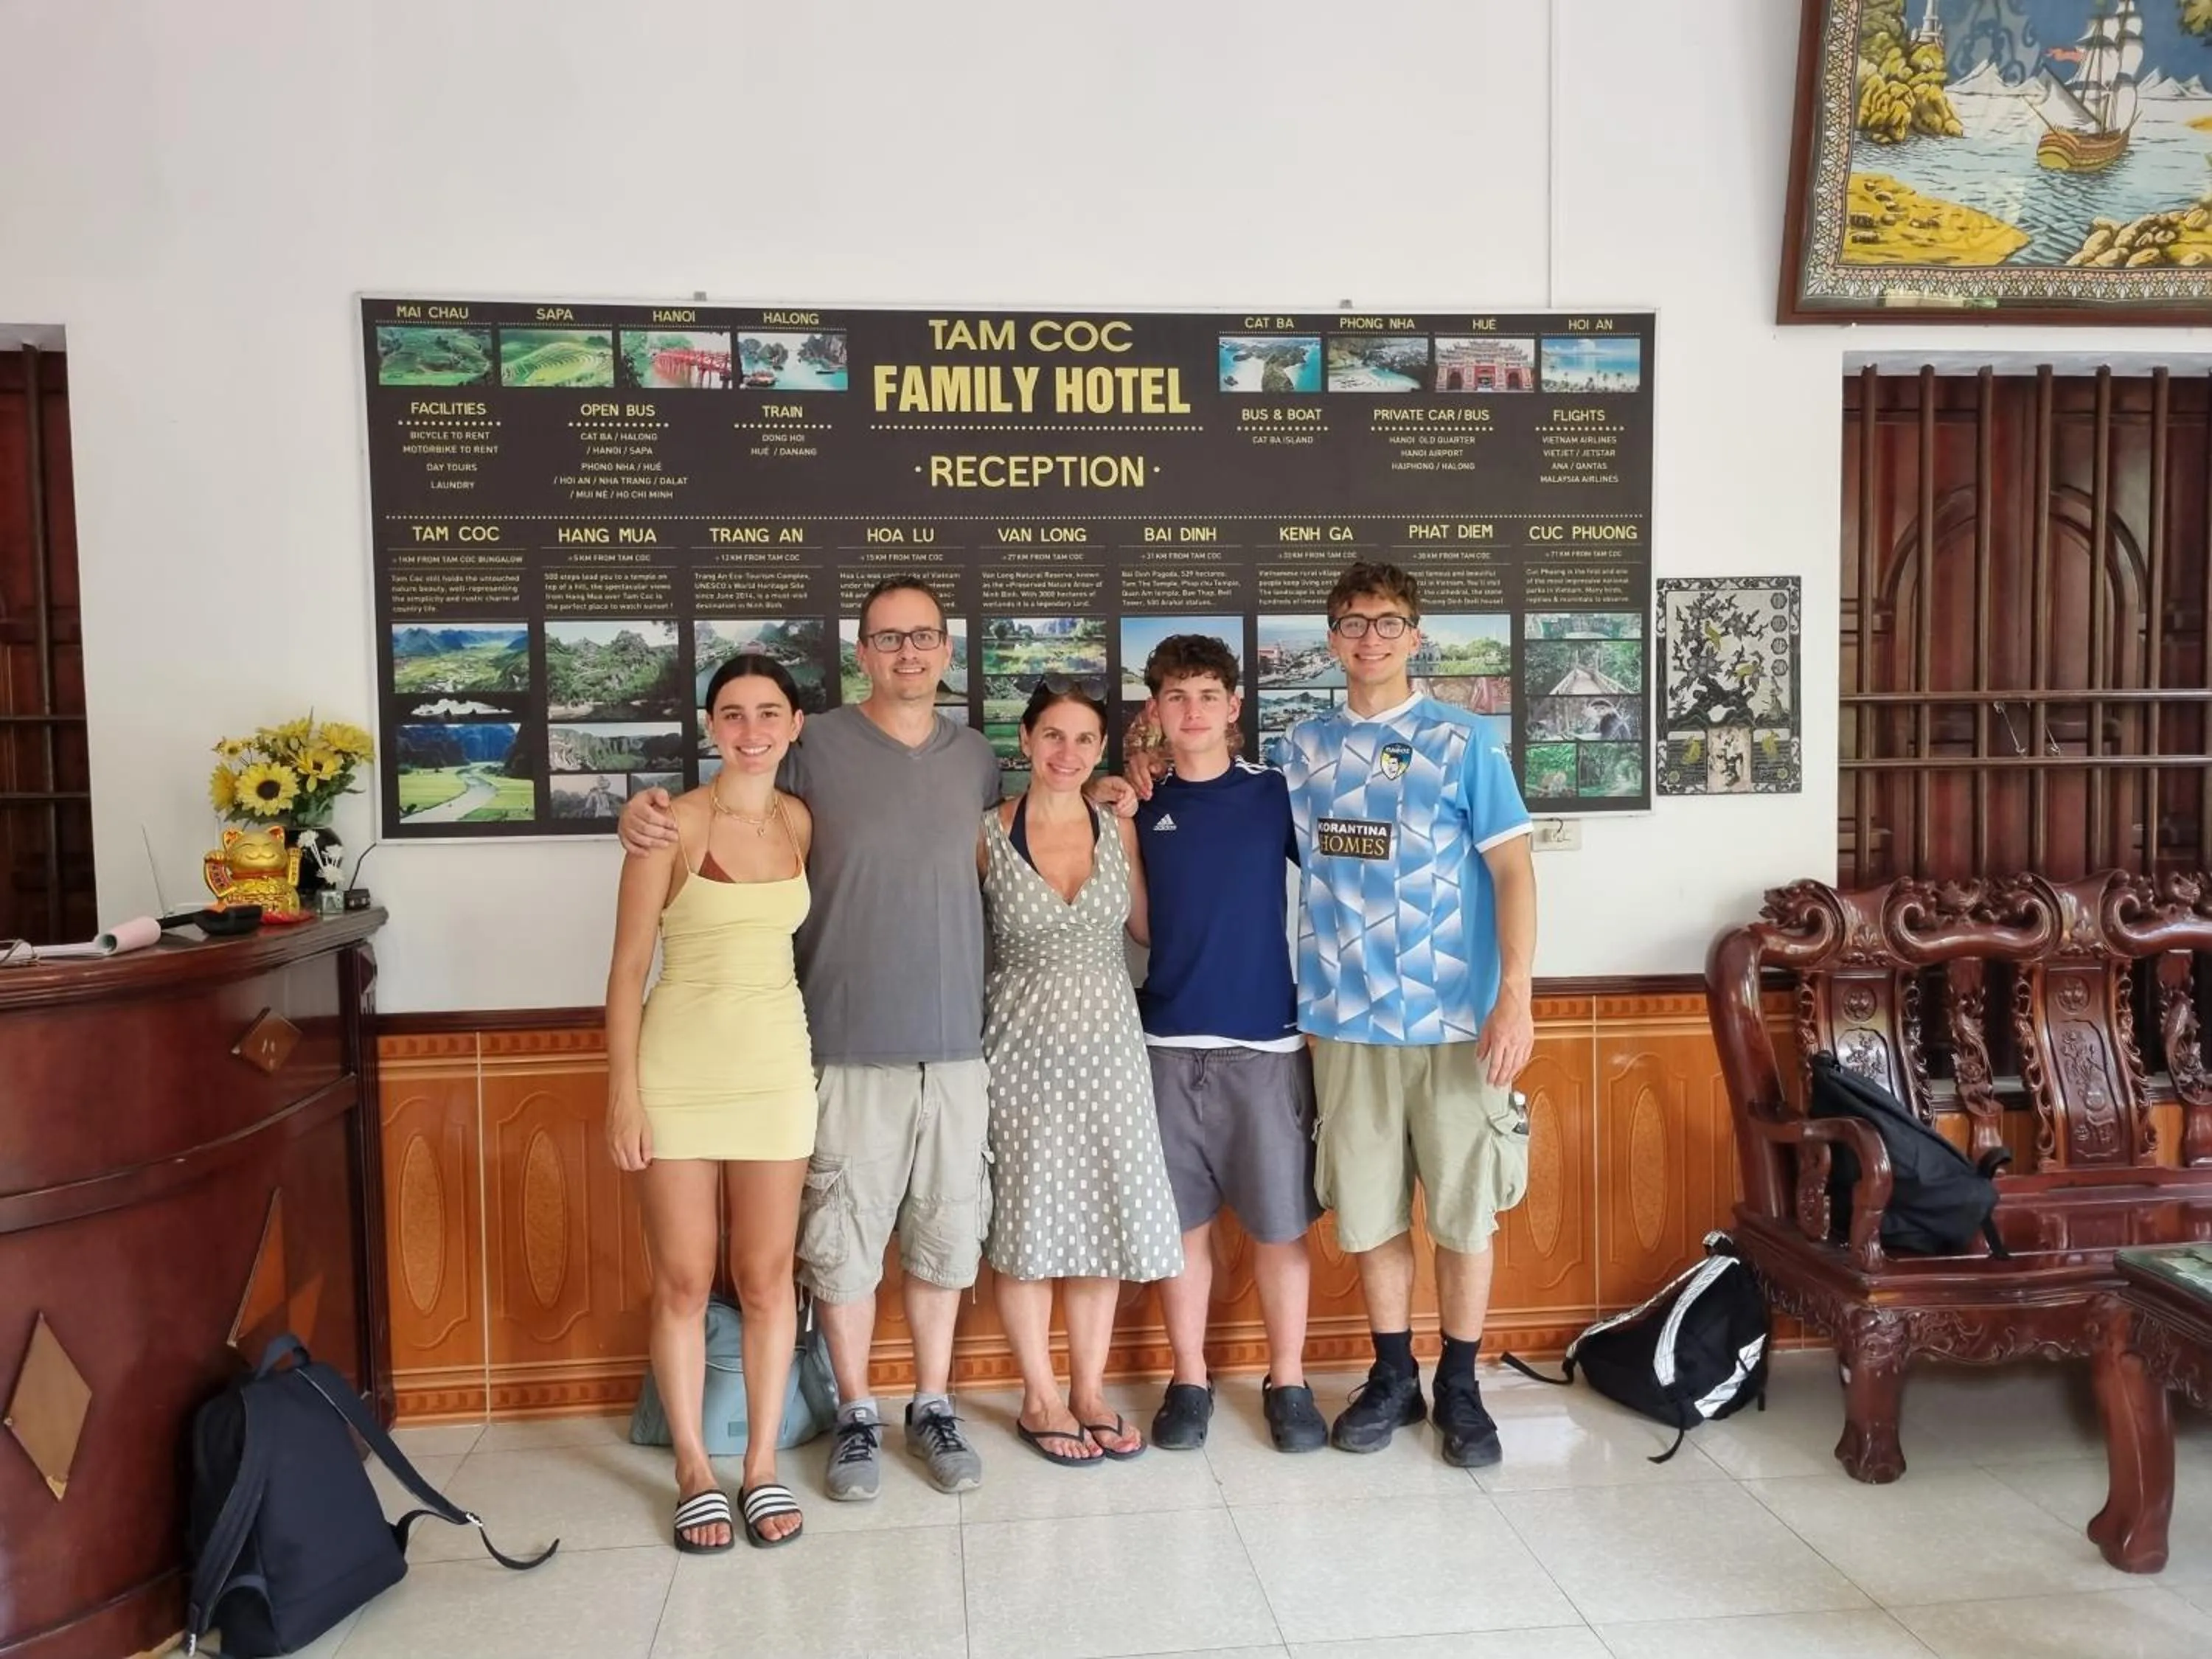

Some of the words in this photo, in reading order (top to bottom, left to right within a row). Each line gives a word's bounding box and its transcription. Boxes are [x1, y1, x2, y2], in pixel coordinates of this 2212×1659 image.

[396, 306, 422, 319] MAI
[428, 307, 468, 319] CHAU
[536, 308, 574, 320] SAPA
[653, 310, 696, 321] HANOI
[764, 313, 819, 324] HALONG
[1245, 317, 1270, 328] CAT
[1276, 318, 1294, 328] BA
[1340, 318, 1383, 329] PHONG
[1390, 319, 1416, 329] NHA
[1569, 319, 1589, 330] HOI
[1596, 319, 1613, 330] AN
[929, 320, 1015, 350] TAM
[1030, 321, 1133, 352] COC
[874, 366, 1040, 412] FAMILY
[1056, 367, 1191, 413] HOTEL
[411, 403, 487, 414] FACILITIES
[581, 404, 619, 416] OPEN
[627, 405, 655, 416] BUS
[762, 406, 802, 417] TRAIN
[1242, 408, 1268, 420] BUS
[1273, 408, 1282, 420] &
[1287, 408, 1321, 420] BOAT
[1374, 409, 1424, 420] PRIVATE
[1554, 410, 1604, 421] FLIGHTS
[931, 456, 1144, 487] RECEPTION
[413, 526, 448, 540] TAM
[459, 526, 499, 541] COC
[559, 529, 609, 543] HANG
[619, 528, 656, 543] MUA
[709, 528, 769, 542] TRANG
[779, 529, 802, 542] AN
[867, 528, 904, 542] HOA
[913, 529, 933, 542] LU
[998, 528, 1032, 541] VAN
[1041, 528, 1086, 541] LONG
[1144, 528, 1171, 541] BAI
[1180, 528, 1216, 541] DINH
[1280, 527, 1320, 540] KENH
[1329, 526, 1353, 540] GA
[1410, 525, 1450, 538] PHAT
[1458, 525, 1492, 538] DIEM
[1529, 526, 1563, 540] CUC
[1572, 526, 1637, 539] PHUONG
[1321, 835, 1385, 857] HOMES
